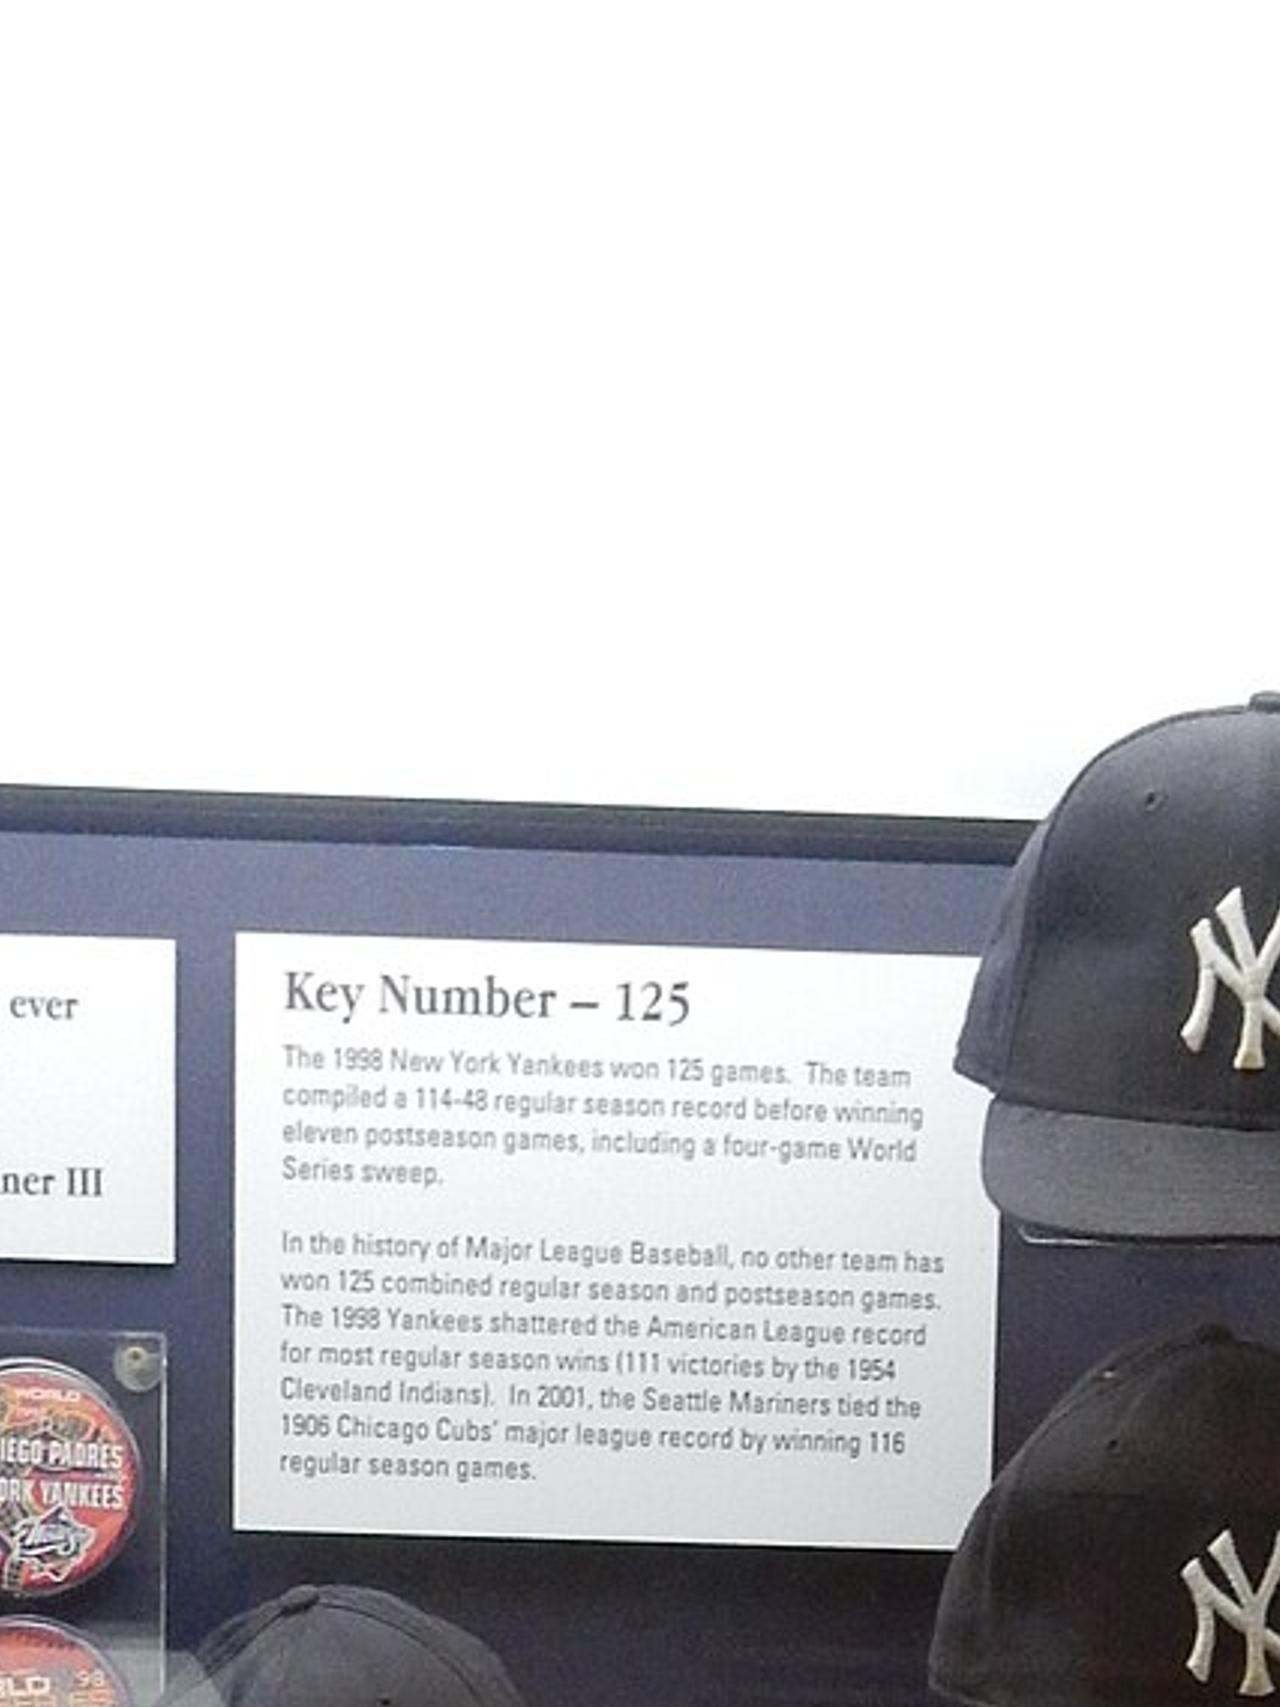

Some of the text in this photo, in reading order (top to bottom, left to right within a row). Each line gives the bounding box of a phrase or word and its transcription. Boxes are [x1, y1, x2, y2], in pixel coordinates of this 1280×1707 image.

[10, 997, 78, 1021] ever
[286, 972, 364, 1025] Key
[380, 974, 556, 1018] Number
[619, 981, 689, 1027] 125
[283, 1044, 910, 1088] The 1998 New York Yankees won 125 games. The team
[283, 1085, 923, 1131] compiled a 114-48 regular season record before winning
[68, 1167, 101, 1197] III
[48, 1442, 124, 1469] PADRES
[40, 1481, 124, 1509] YANKEES
